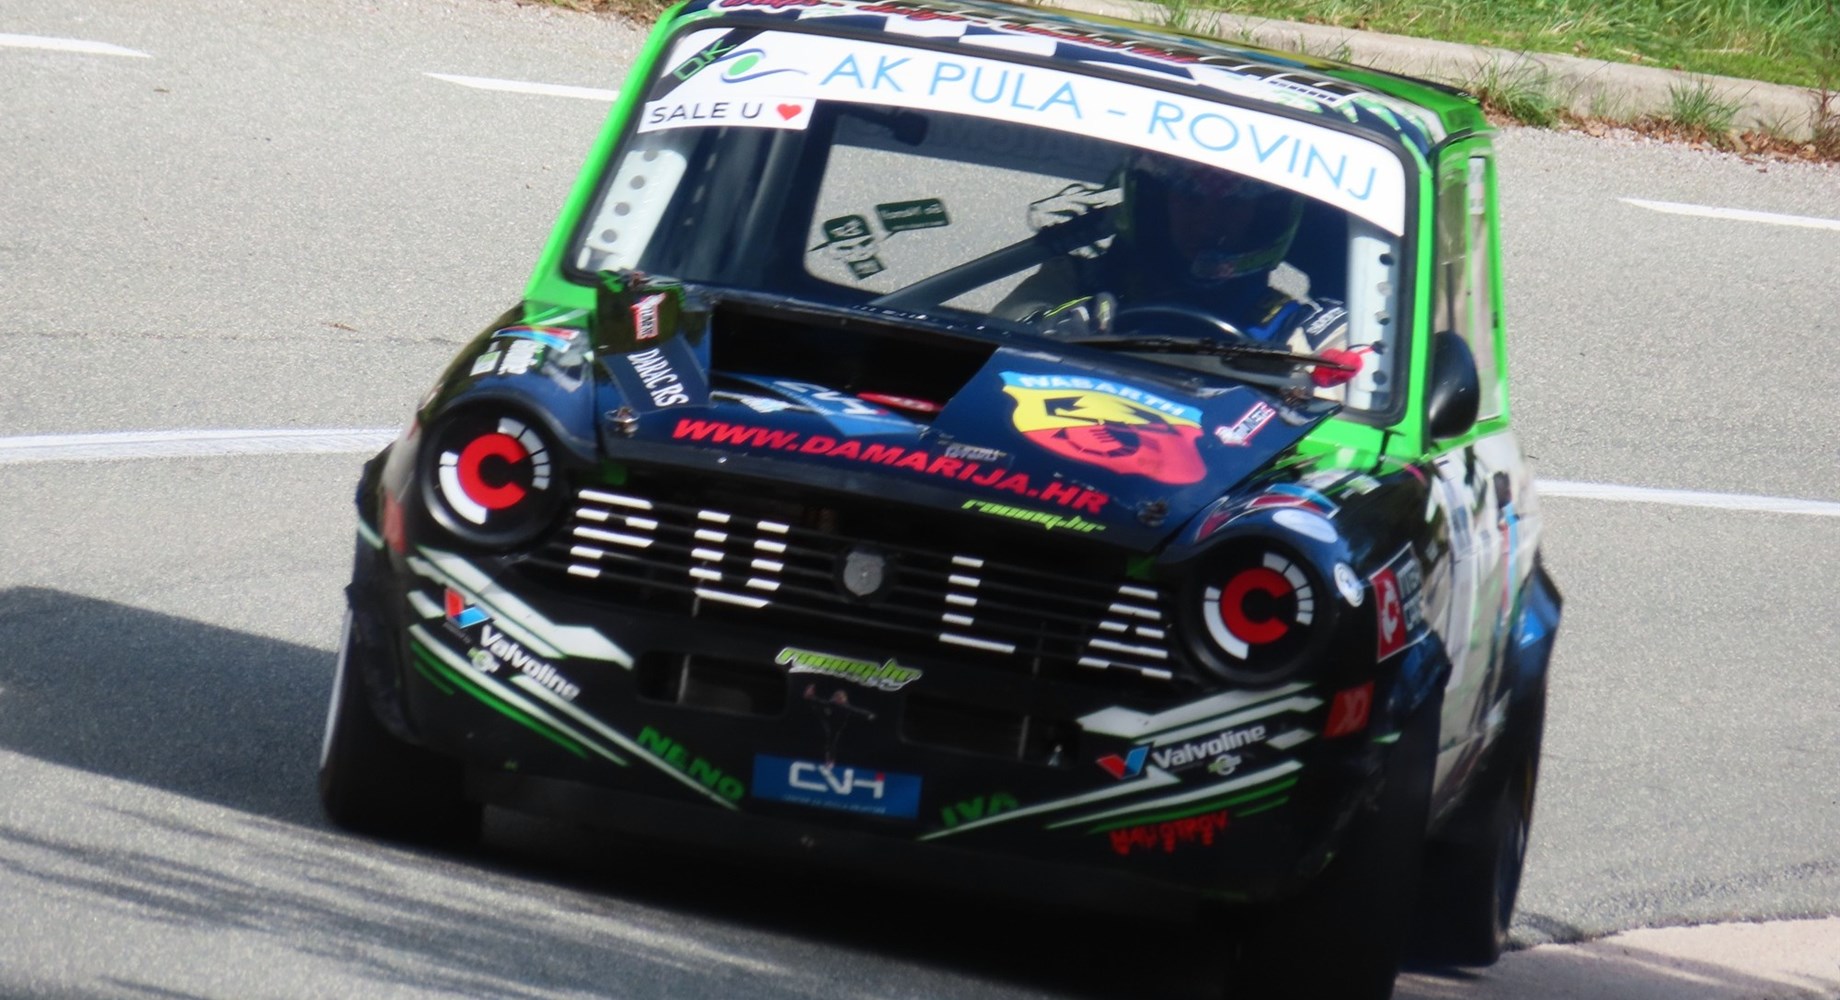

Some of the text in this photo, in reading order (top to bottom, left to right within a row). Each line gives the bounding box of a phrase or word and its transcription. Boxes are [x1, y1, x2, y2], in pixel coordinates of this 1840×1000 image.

[649, 102, 763, 124] SALE U
[819, 53, 911, 93] AK
[929, 61, 1082, 120] PULA
[1147, 99, 1377, 201] ROVINJ
[627, 348, 690, 407] DARAC RS
[672, 418, 1110, 515] WWW.DAMARIJA.HR
[480, 624, 581, 701] Valvoline
[636, 726, 744, 800] NENO
[1152, 725, 1266, 769] Valvoline
